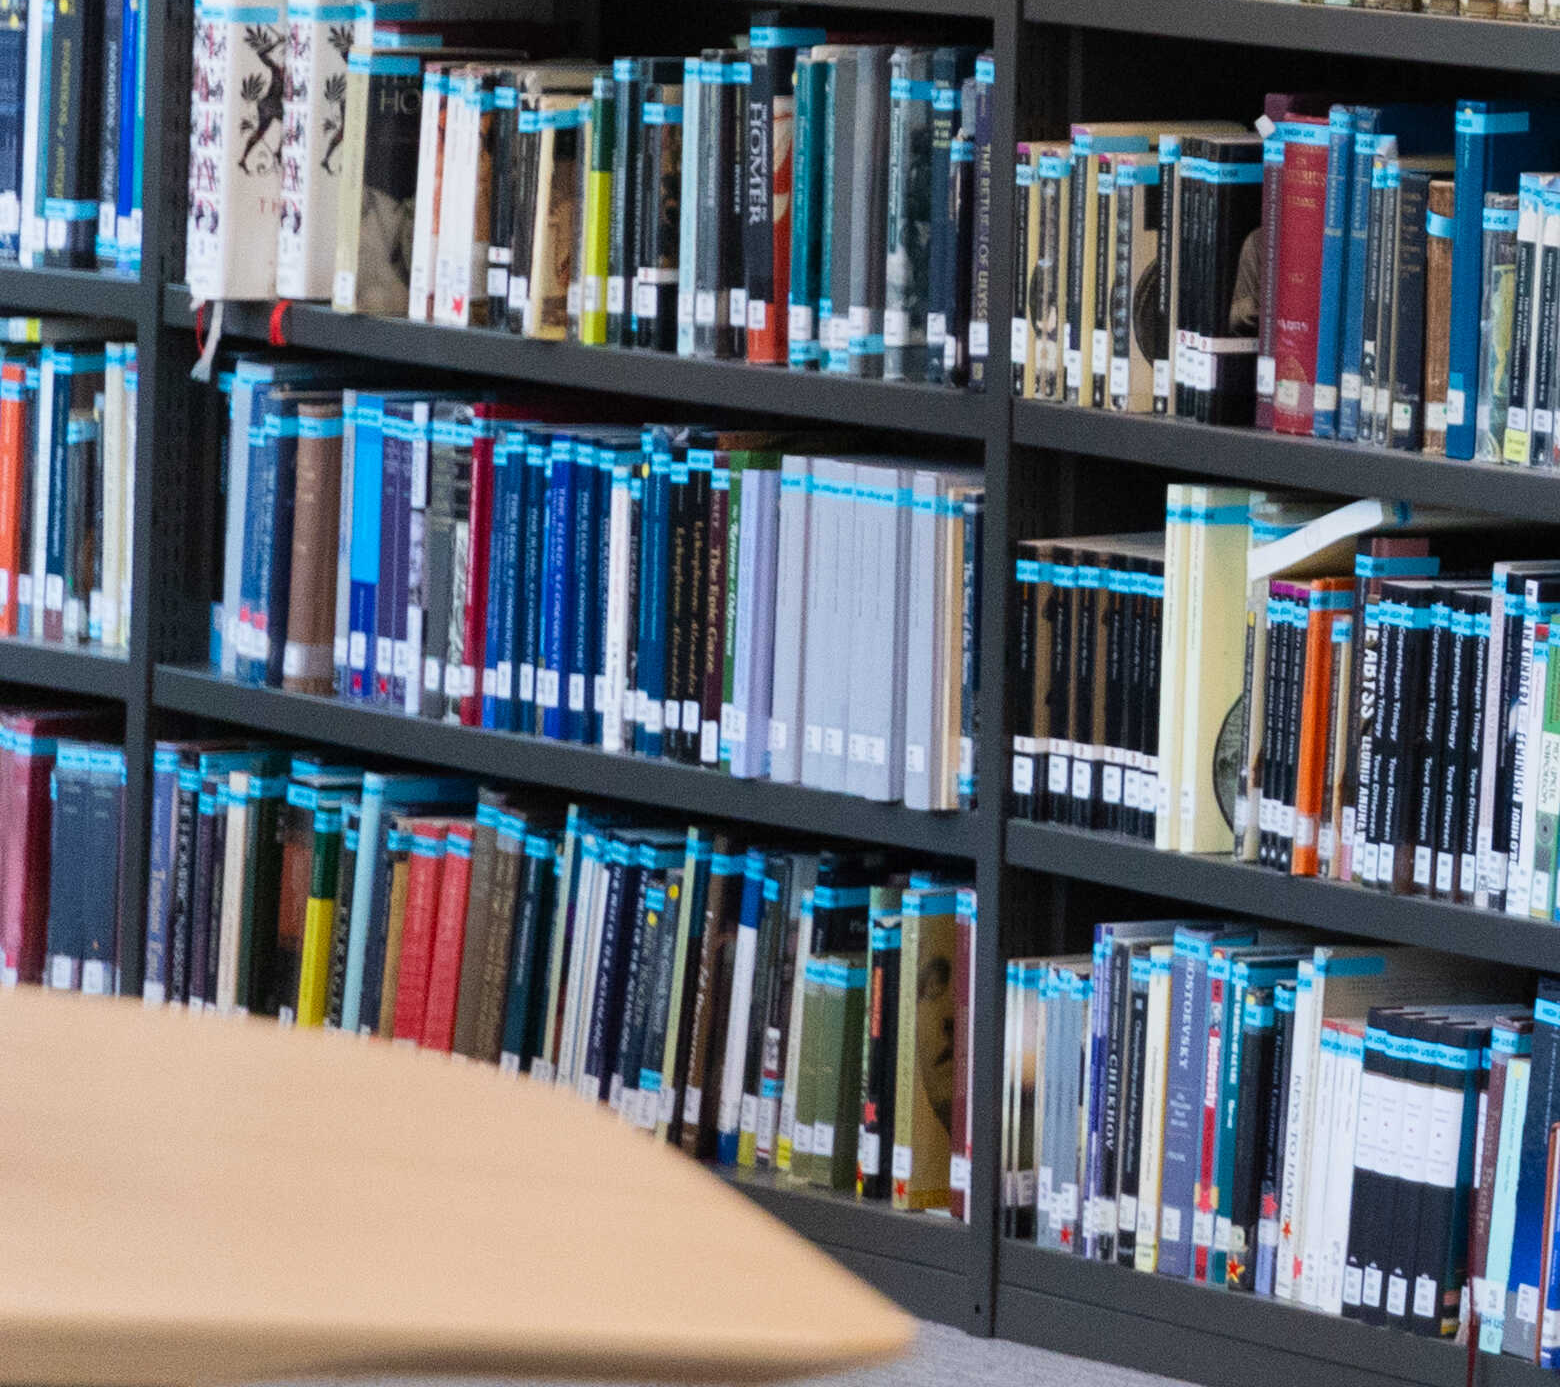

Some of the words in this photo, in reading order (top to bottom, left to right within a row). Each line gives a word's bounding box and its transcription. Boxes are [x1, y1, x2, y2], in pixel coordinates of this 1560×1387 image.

[748, 101, 762, 225] HOMER
[1360, 650, 1379, 720] ABYSS
[1374, 699, 1387, 740] Trilogy
[1389, 699, 1402, 742] Trilogy
[1424, 699, 1437, 741] Trilogy
[1447, 708, 1459, 751] Trilogy
[1470, 710, 1482, 752] Trilogy
[1373, 753, 1383, 782] Tove
[1388, 756, 1398, 784] Tove
[1423, 756, 1433, 785] Tove
[1446, 764, 1456, 791] Tove
[1469, 767, 1479, 793] Tove
